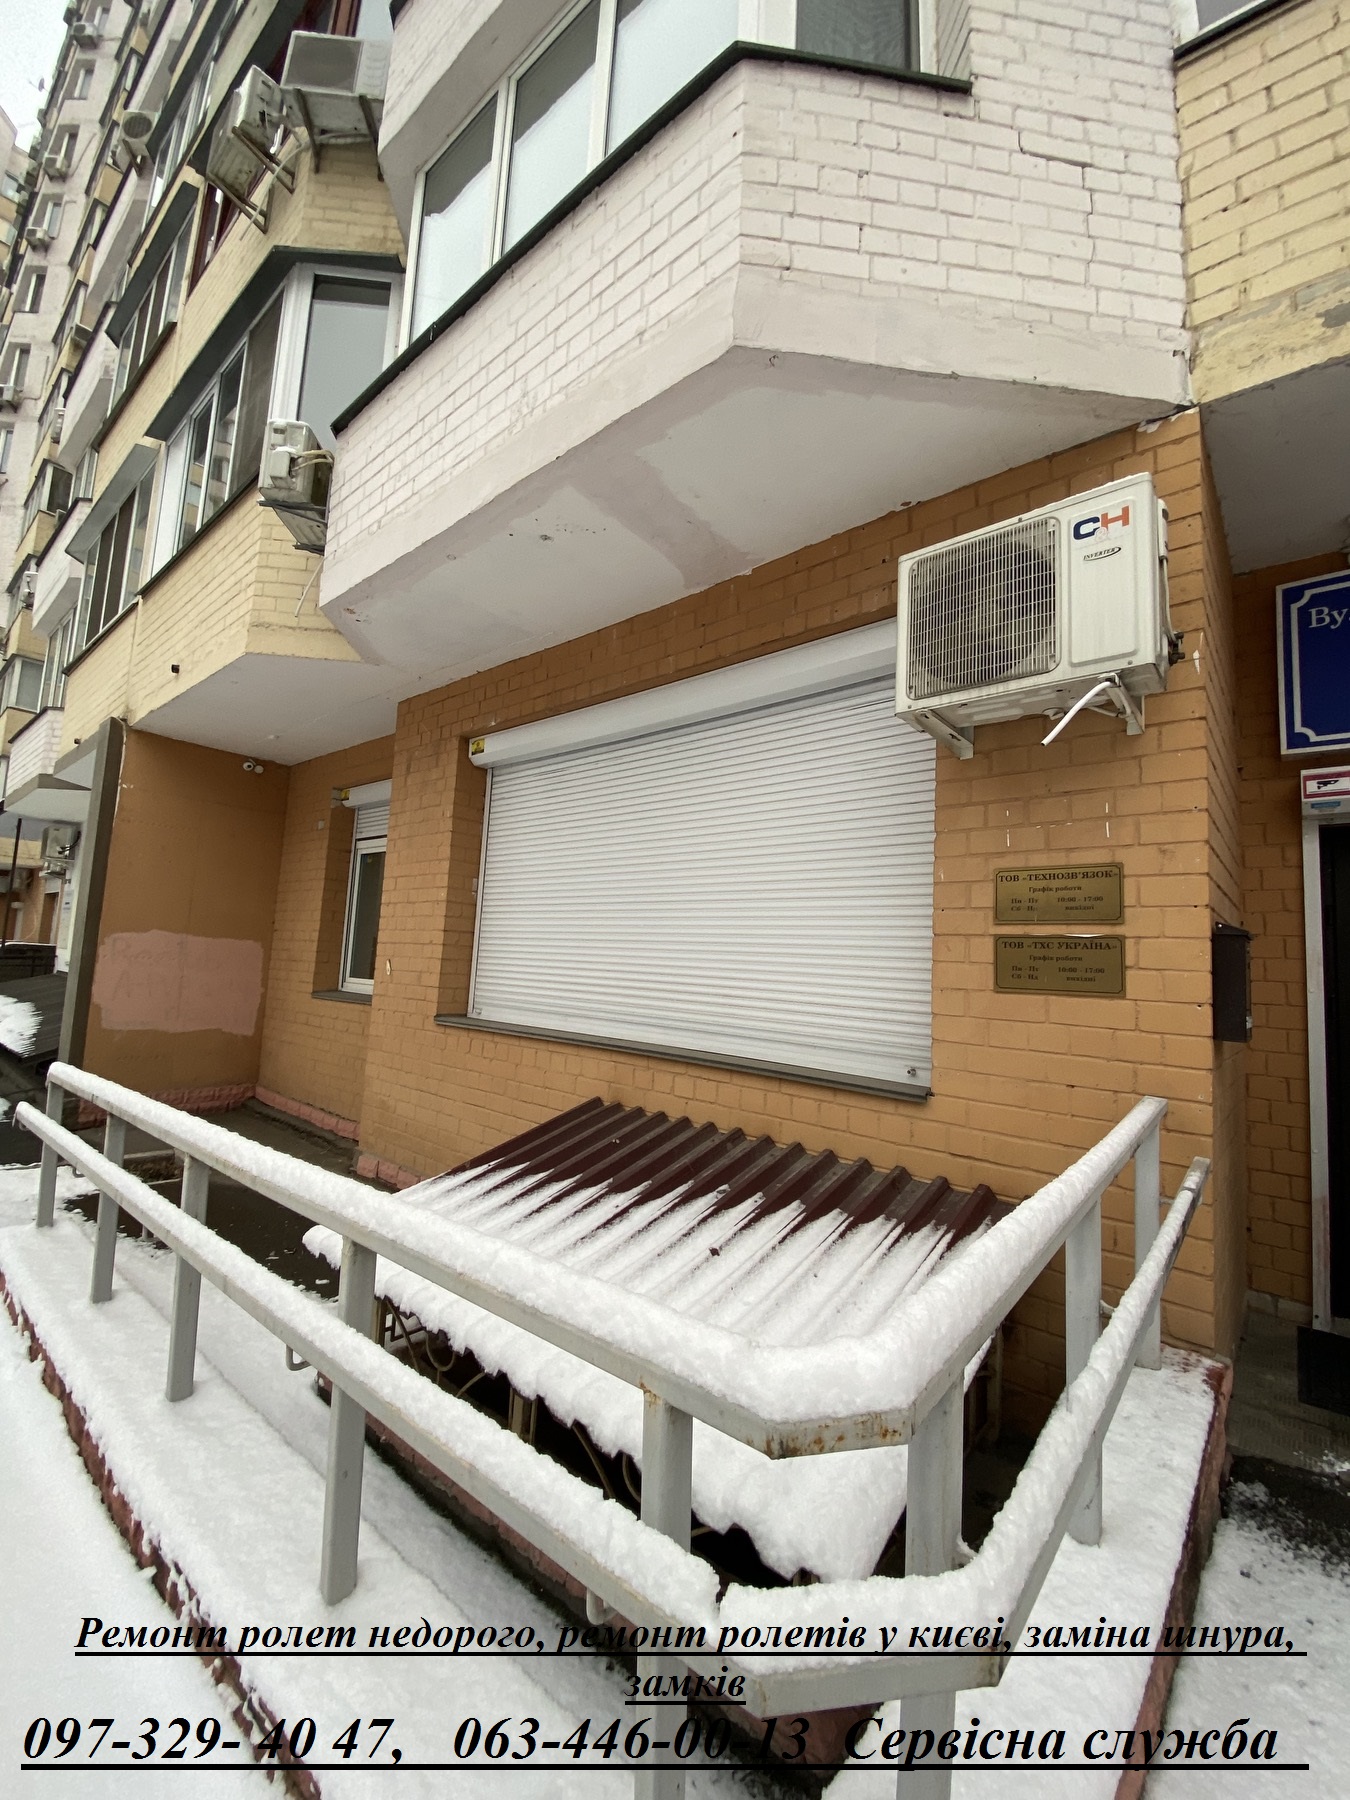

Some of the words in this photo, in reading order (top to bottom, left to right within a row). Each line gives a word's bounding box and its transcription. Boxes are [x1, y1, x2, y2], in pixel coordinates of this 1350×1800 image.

[1083, 547, 1116, 560] INVERTER
[1308, 606, 1350, 629] Ву
[999, 874, 1020, 883] ТОВ
[1002, 941, 1024, 949] ТОВ
